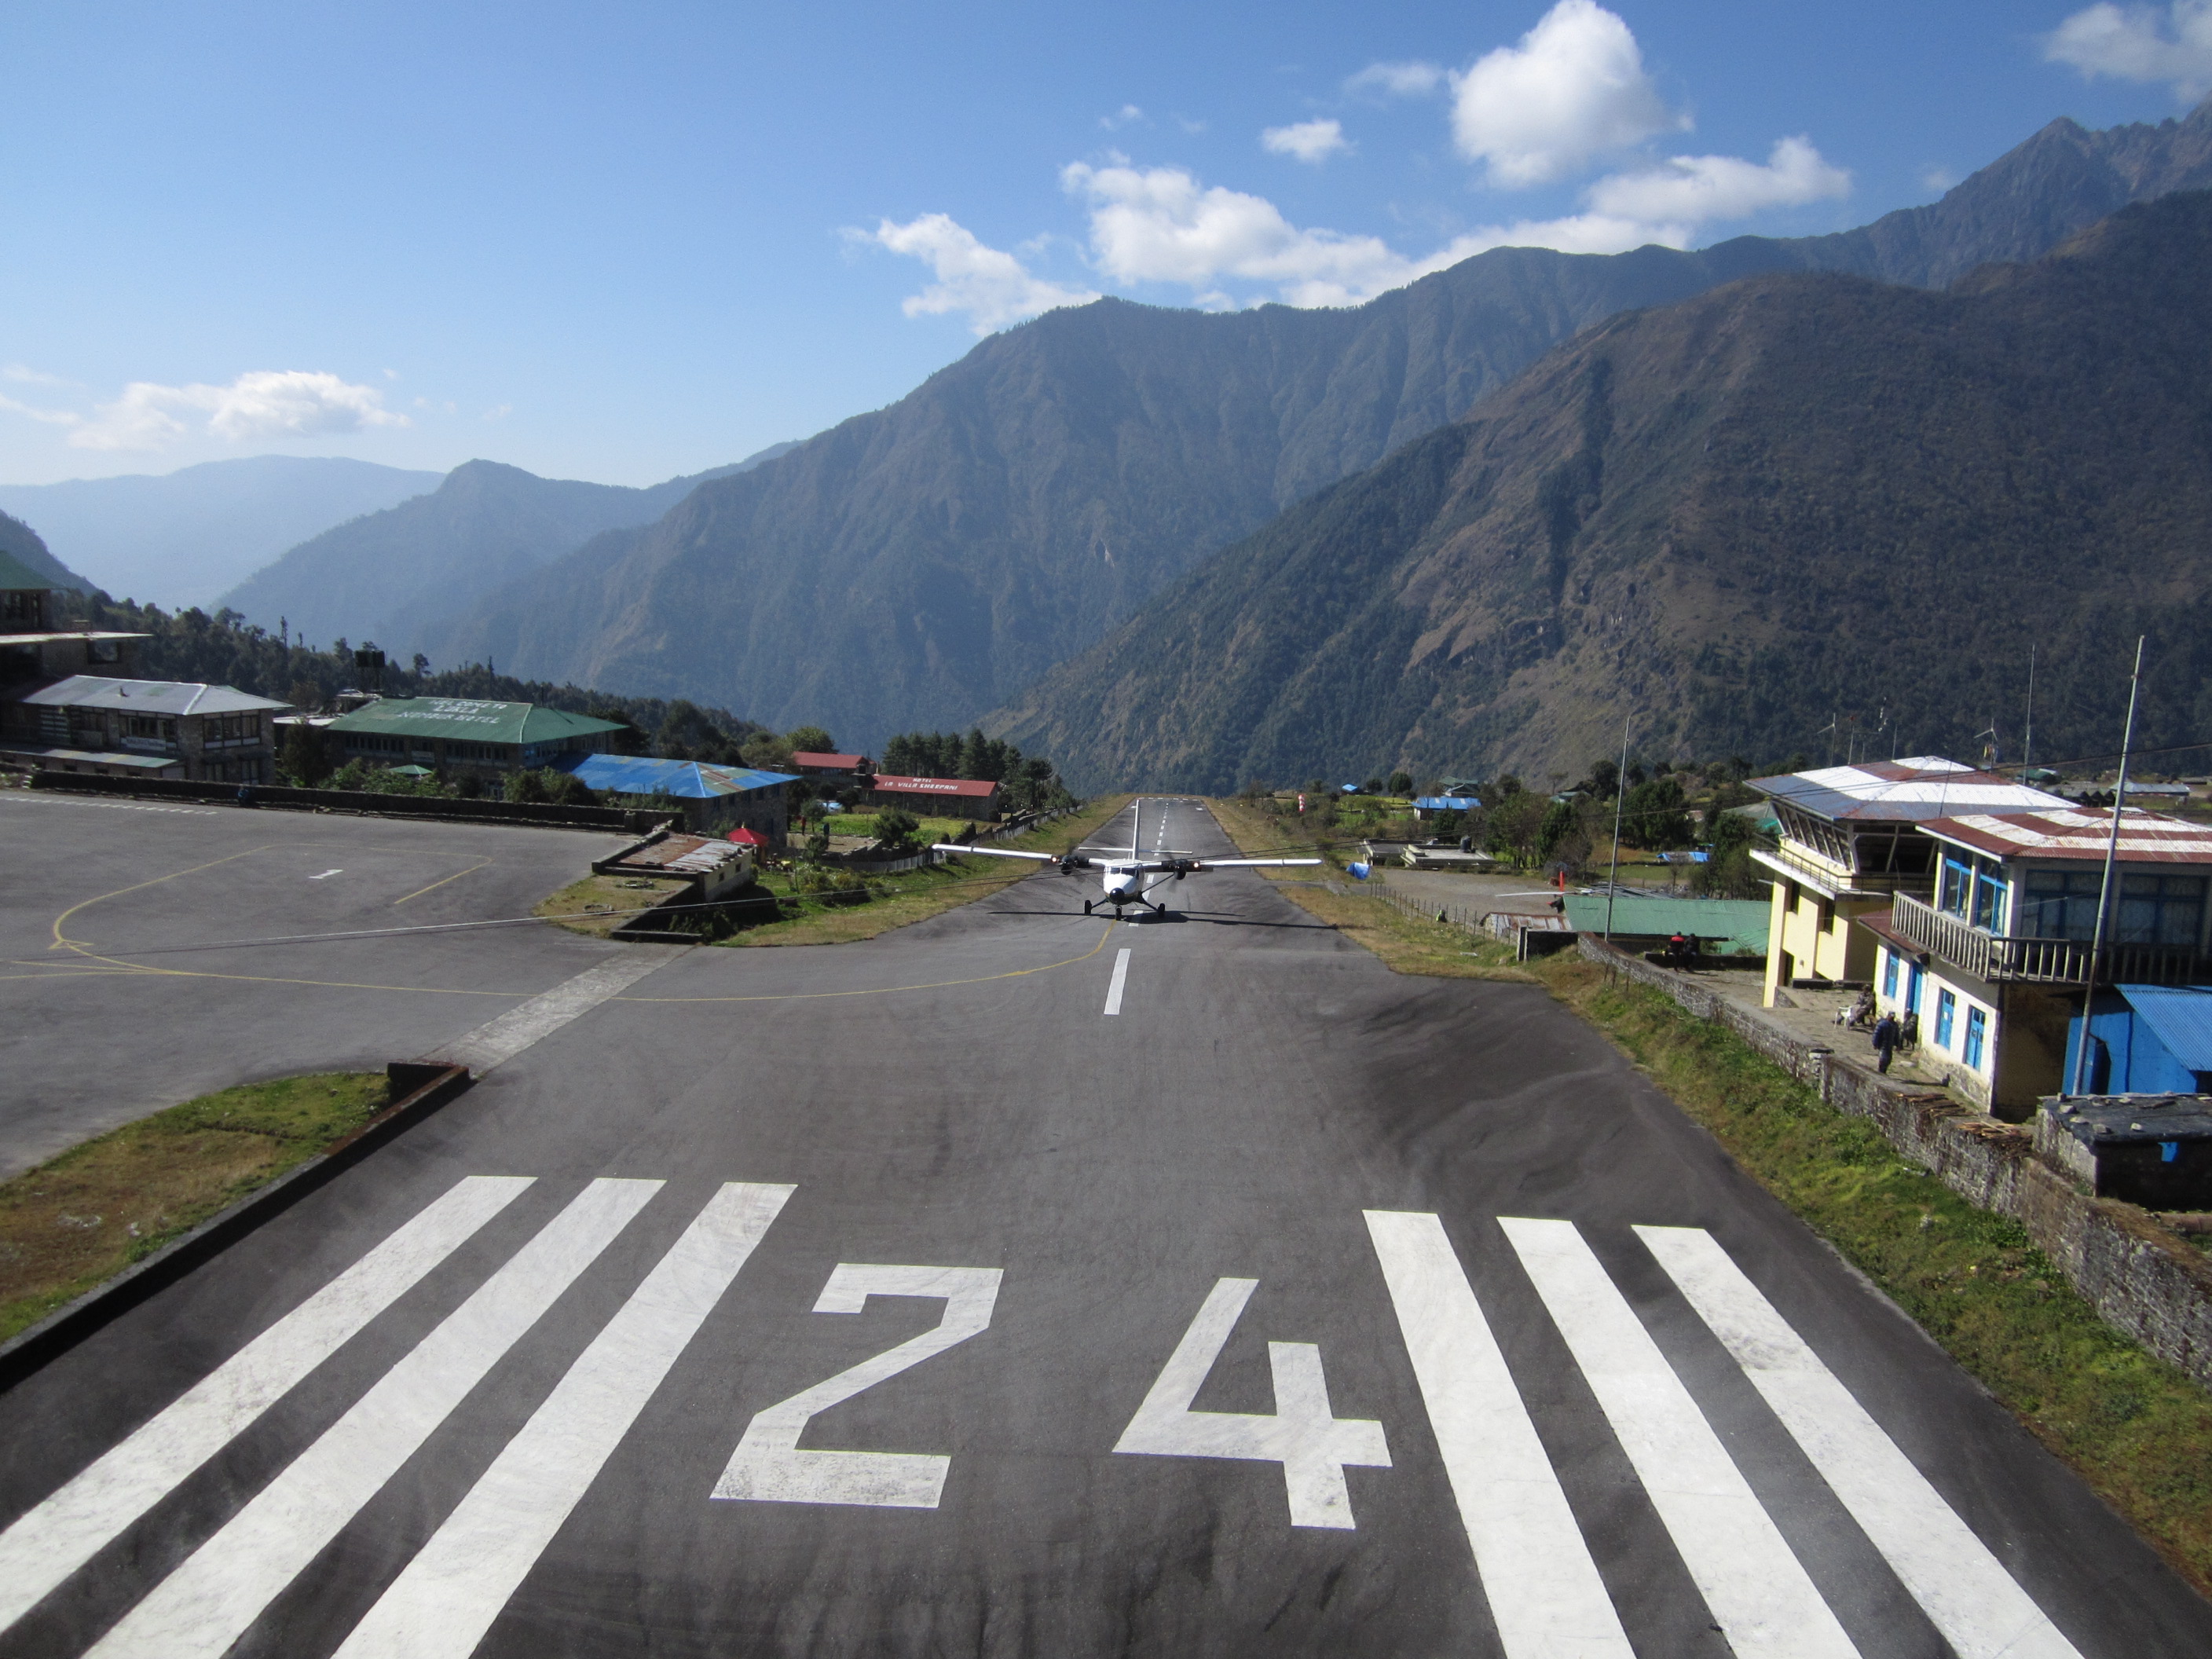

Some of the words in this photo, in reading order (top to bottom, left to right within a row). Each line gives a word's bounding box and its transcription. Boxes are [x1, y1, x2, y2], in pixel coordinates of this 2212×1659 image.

[433, 705, 479, 714] LUKLA
[454, 715, 500, 724] HOTEL
[709, 1263, 1393, 1529] 24
